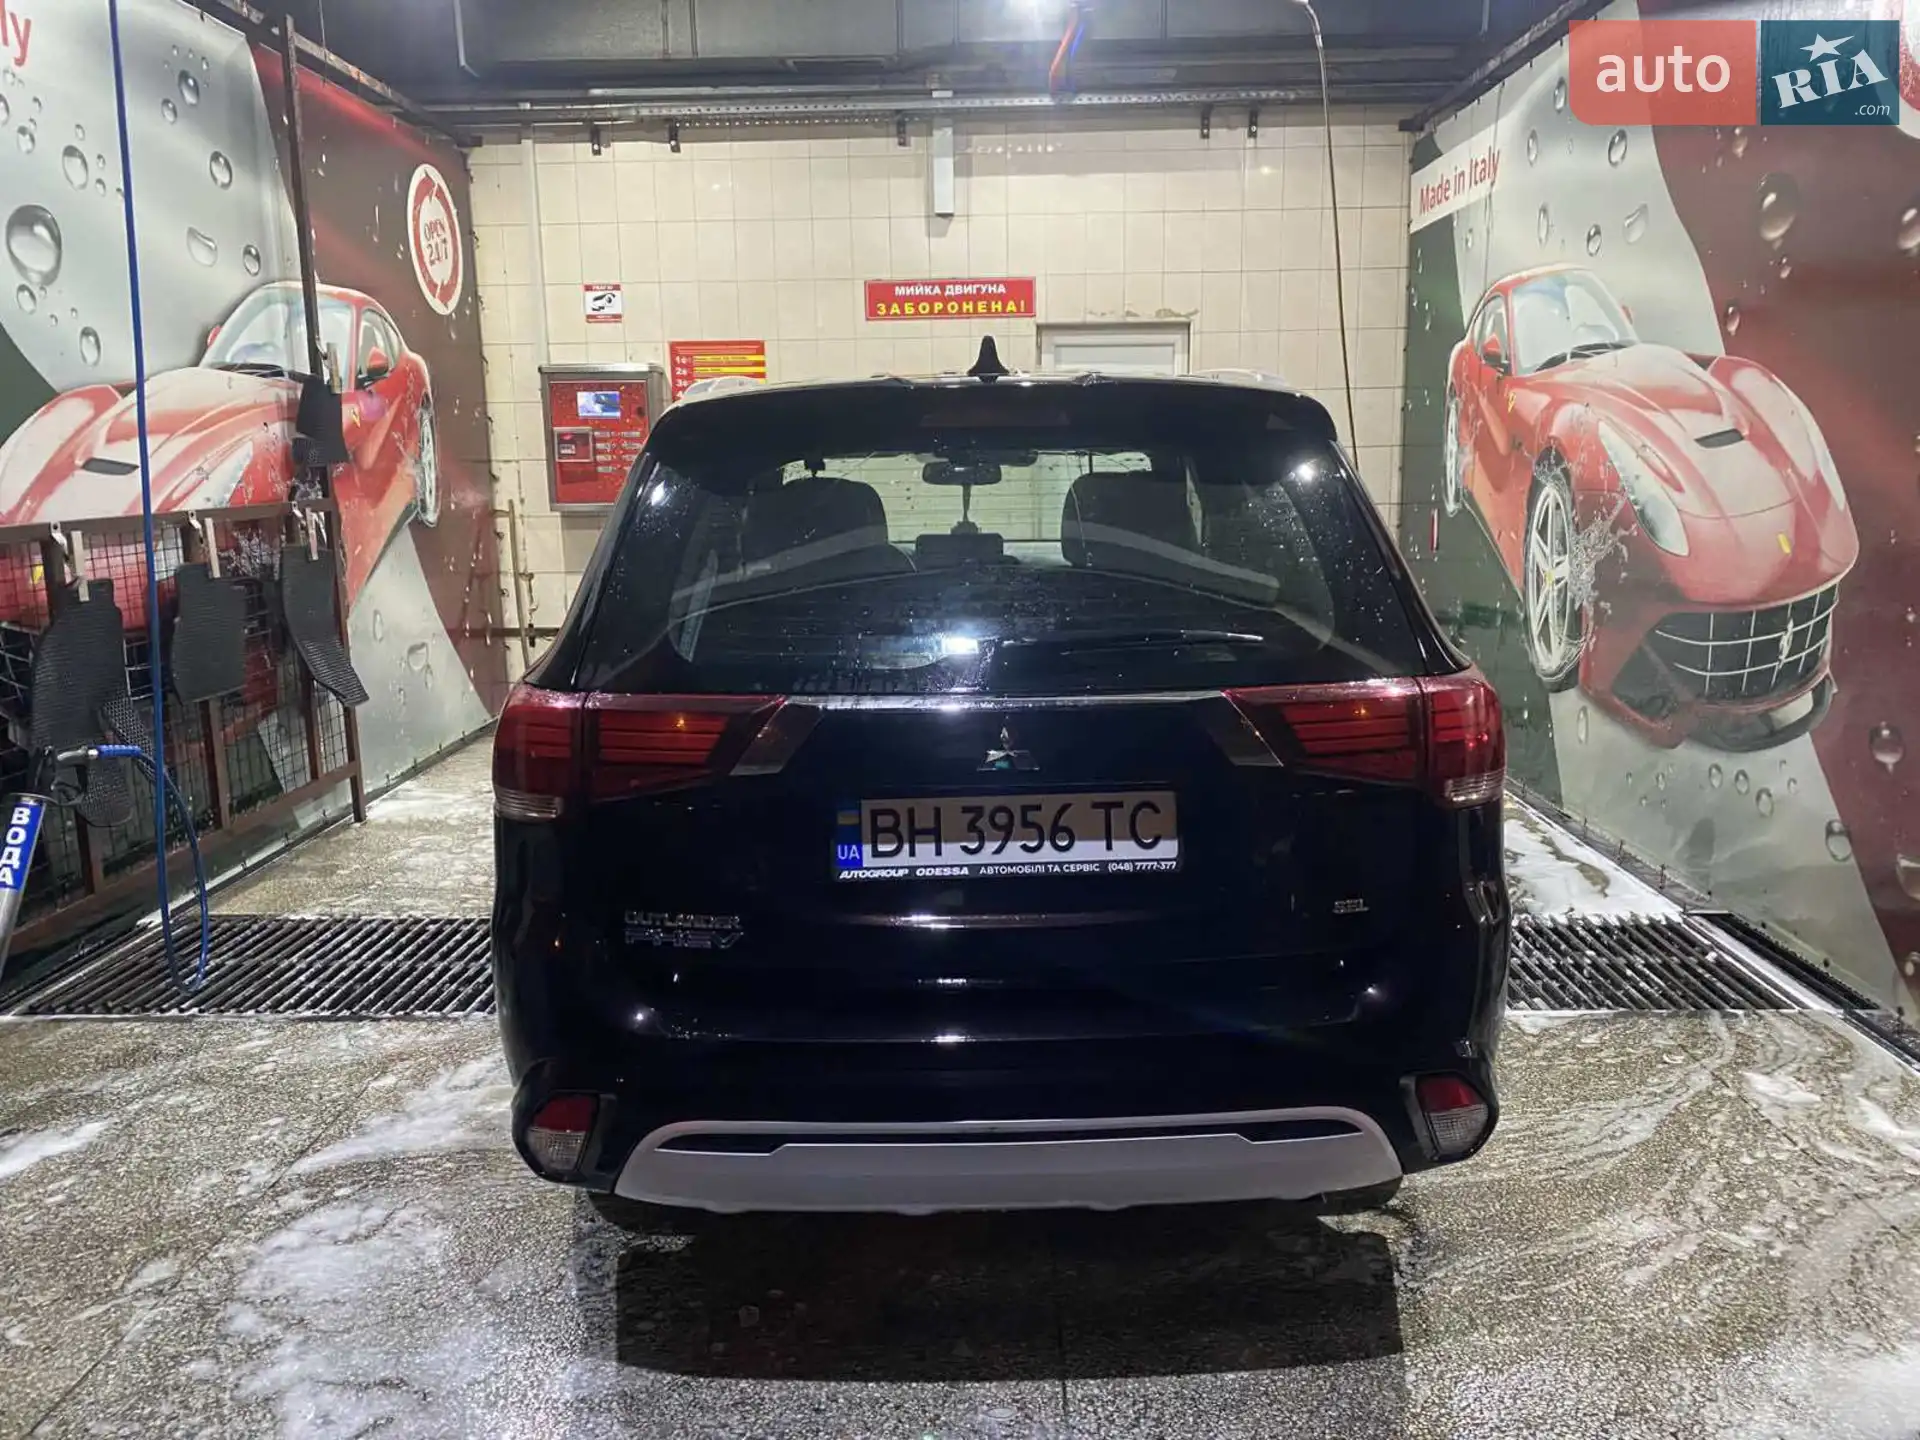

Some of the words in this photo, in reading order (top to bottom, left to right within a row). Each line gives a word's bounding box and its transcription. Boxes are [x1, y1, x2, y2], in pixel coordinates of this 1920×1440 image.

[1420, 172, 1450, 215] Made
[1454, 165, 1466, 197] in
[1469, 145, 1500, 190] Italy
[424, 218, 446, 242] OPEN
[894, 282, 941, 297] МИЙКА
[944, 283, 1006, 297] ДВИГУНА
[876, 299, 1026, 316] ЗАБОРОНЕНА!
[870, 806, 943, 858] BH
[959, 801, 1076, 856] 3956
[1090, 800, 1163, 852] TC
[0, 806, 31, 886] ВОДА
[837, 845, 860, 860] UA
[839, 868, 909, 880] AUTOGROUP
[915, 866, 970, 878] ODESSA
[979, 863, 1045, 876] АВТОМОБІЛІ
[1047, 863, 1061, 874] ТА
[1062, 862, 1101, 873] СЕРВІС
[1107, 860, 1134, 874] (048)
